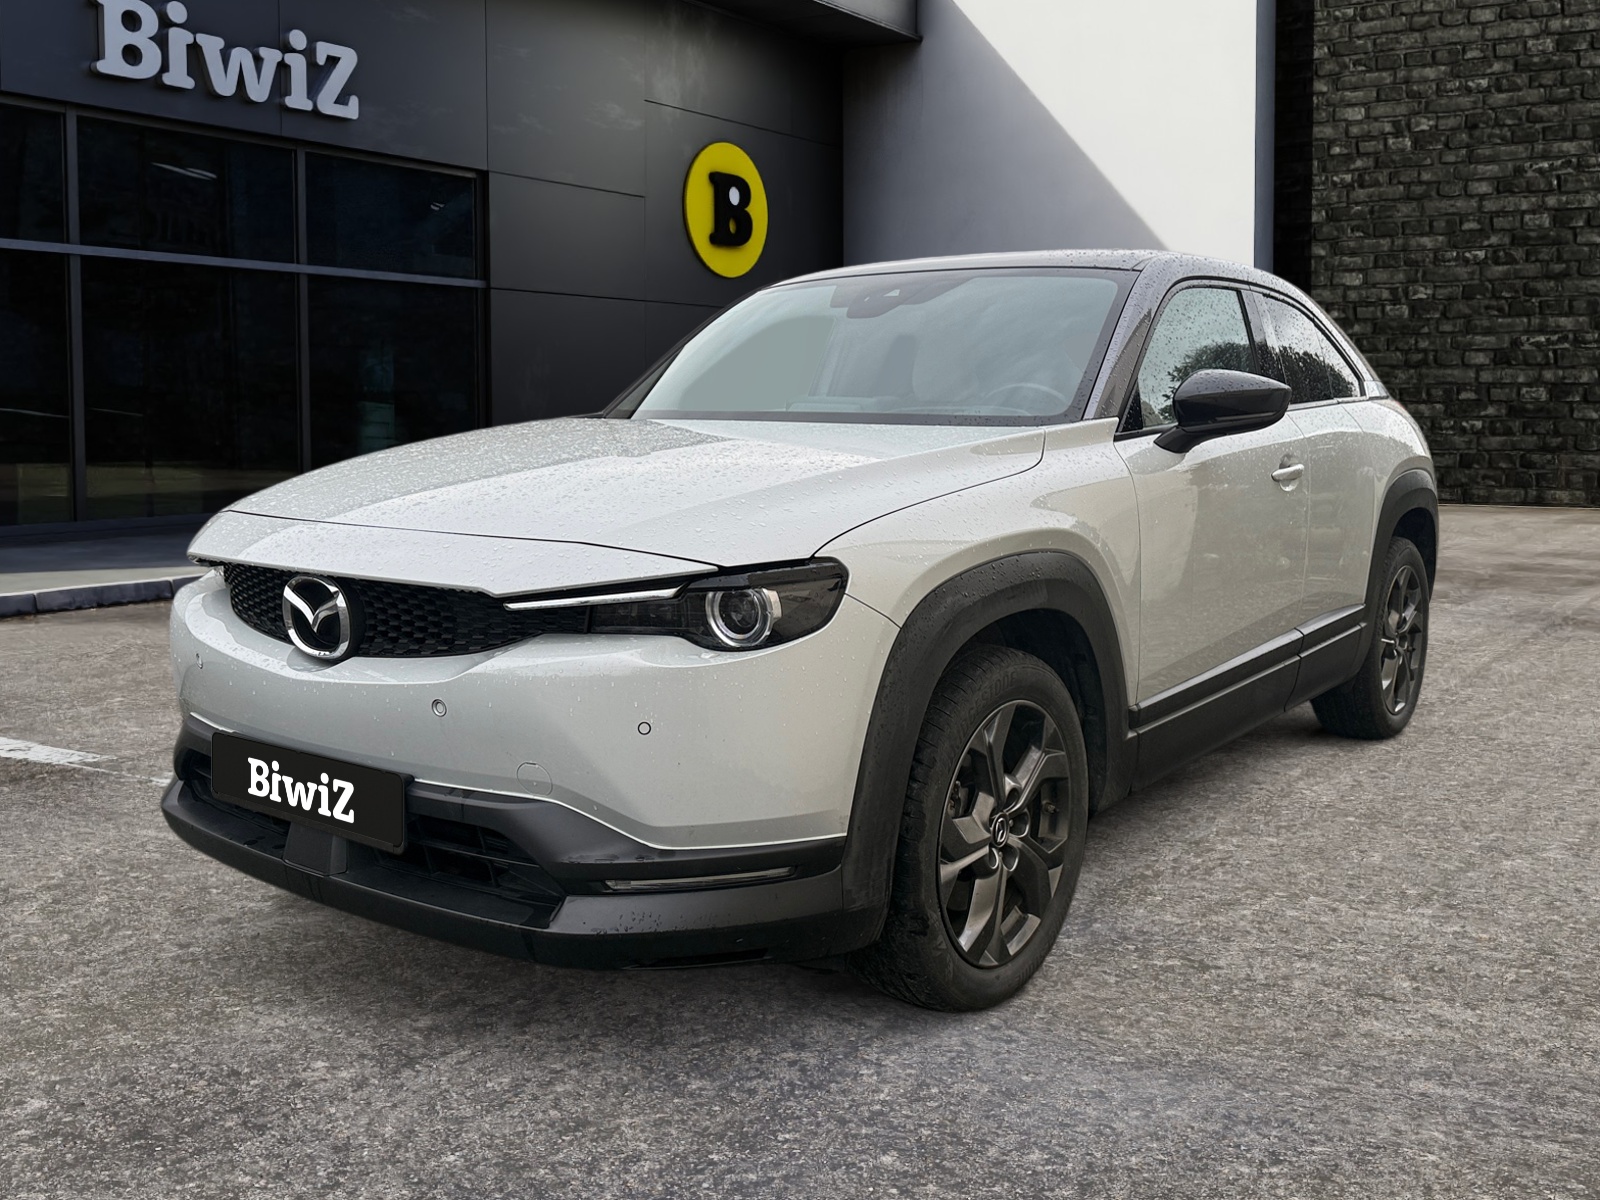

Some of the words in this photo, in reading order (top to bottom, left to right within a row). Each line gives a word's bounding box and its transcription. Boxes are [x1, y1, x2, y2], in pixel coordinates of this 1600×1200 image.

[94, 0, 359, 119] BiwiZ
[709, 171, 753, 247] B
[247, 757, 354, 824] BiwiZ
